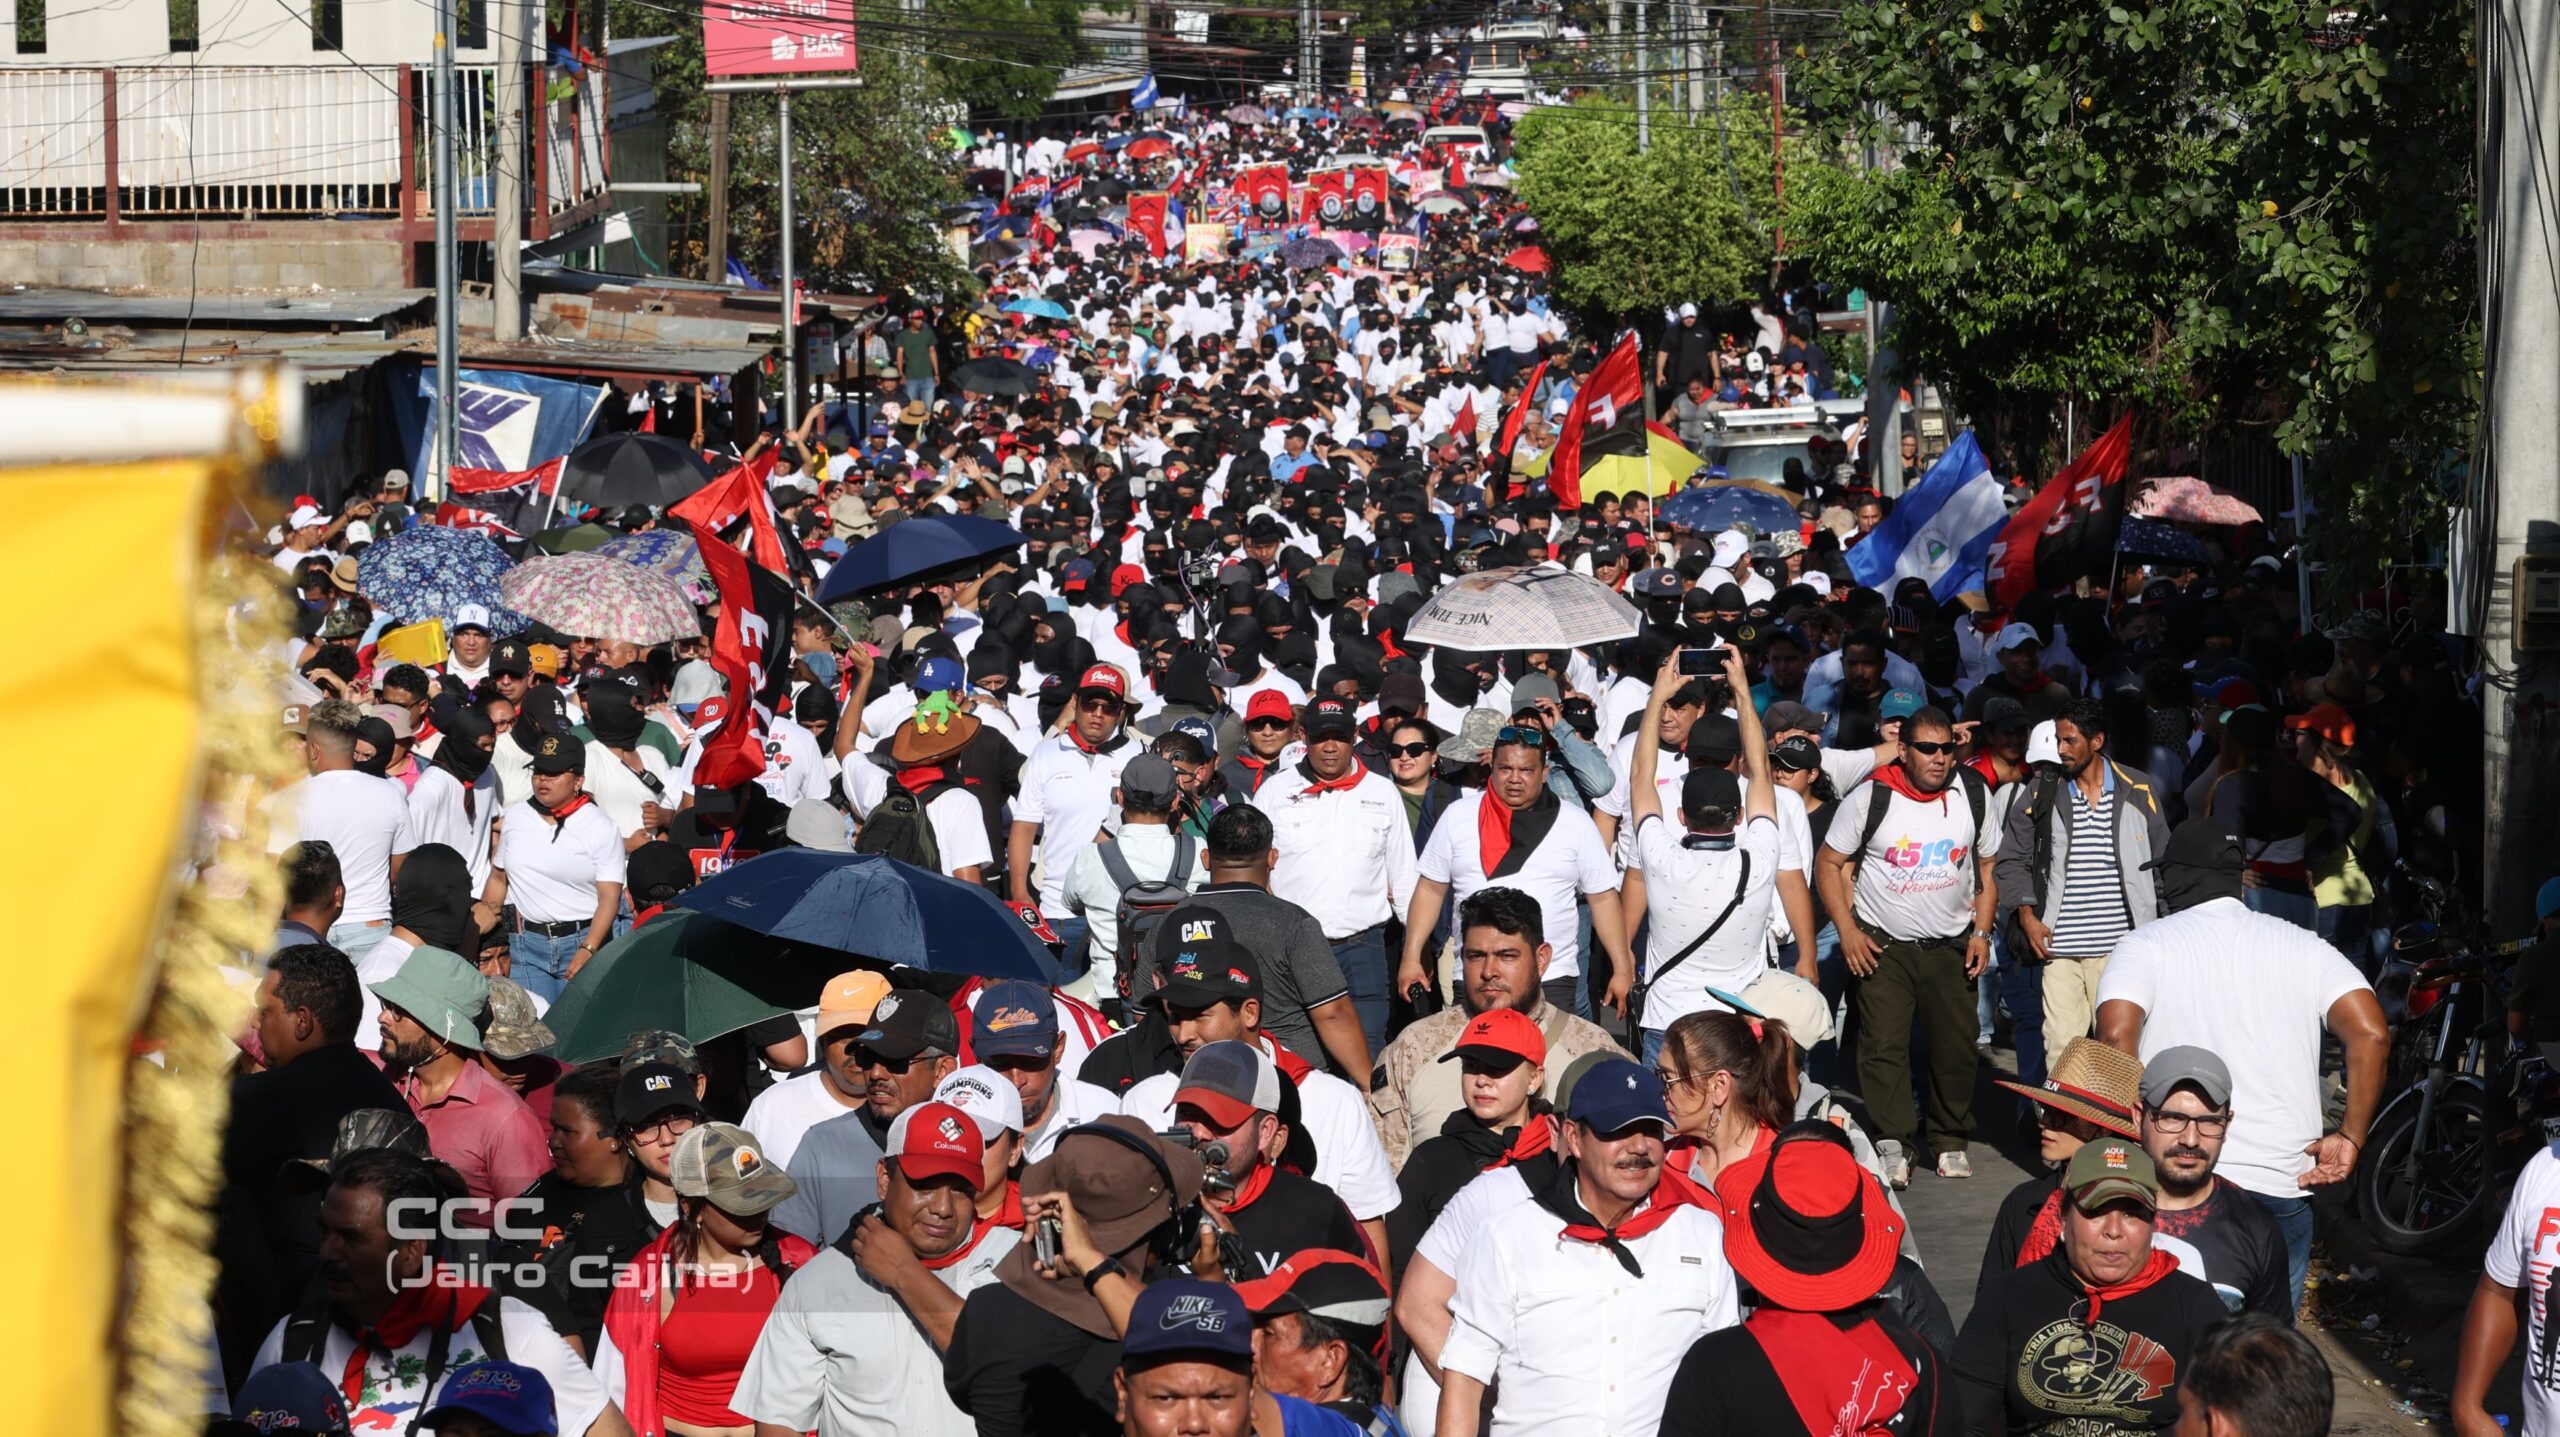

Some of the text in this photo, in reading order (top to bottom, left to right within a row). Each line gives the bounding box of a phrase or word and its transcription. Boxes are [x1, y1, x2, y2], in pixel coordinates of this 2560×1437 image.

[803, 32, 845, 52] BAC
[1455, 612, 1494, 626] NICE
[1321, 703, 1341, 712] 1979
[1883, 838, 1954, 869] 4519
[1181, 920, 1213, 942] CAT
[1184, 970, 1204, 980] 2026
[1230, 973, 1250, 984] FSLN
[645, 1075, 670, 1091] CAT
[940, 1080, 994, 1100] CHAMPIONS
[934, 1141, 967, 1153] Columbia
[1170, 1295, 1214, 1314] NIKE
[1196, 1315, 1225, 1333] SB
